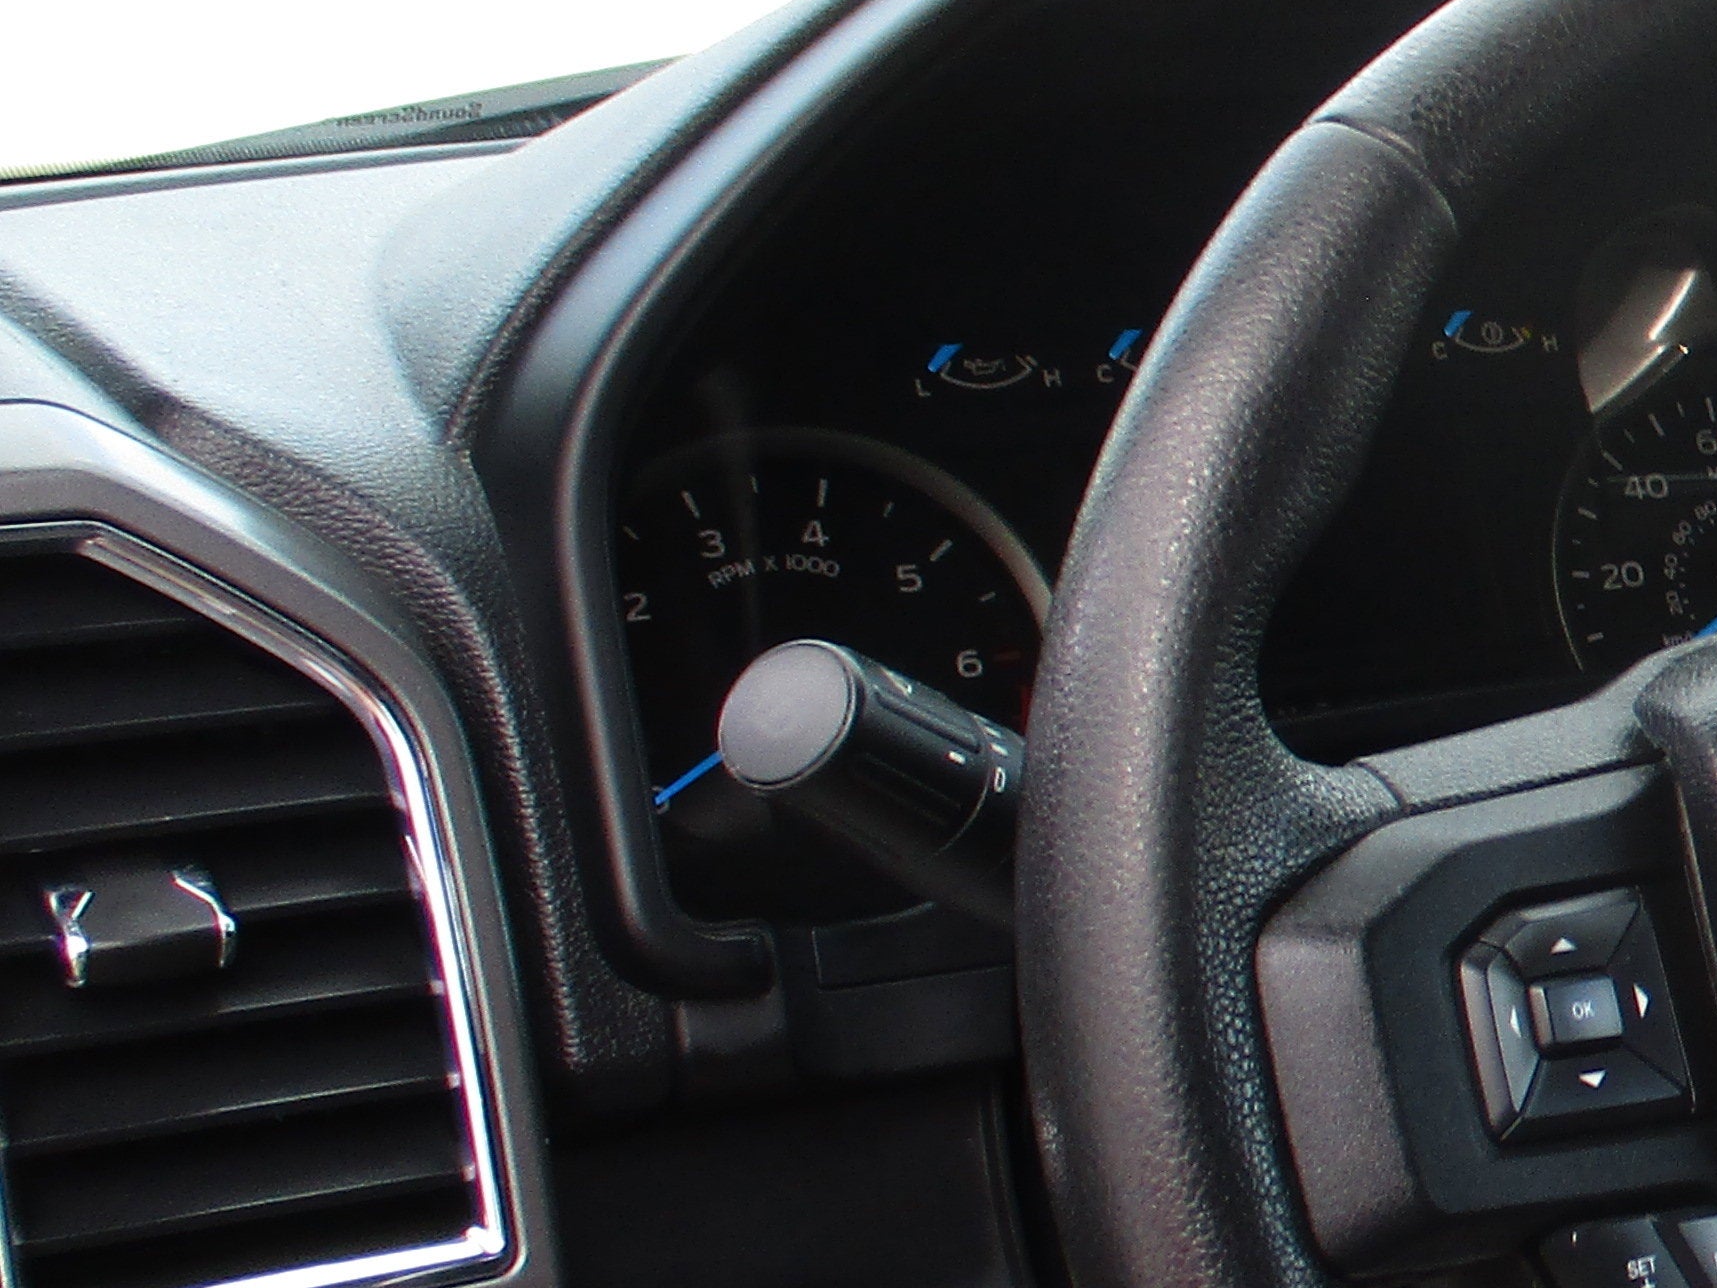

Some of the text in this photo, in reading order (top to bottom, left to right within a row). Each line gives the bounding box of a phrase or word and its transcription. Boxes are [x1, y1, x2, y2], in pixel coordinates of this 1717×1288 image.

[1043, 368, 1062, 387] H
[1096, 364, 1114, 383] C
[915, 379, 931, 397] L
[1625, 472, 1669, 500] 40
[698, 529, 725, 559] 3
[801, 520, 829, 547] 4
[707, 559, 756, 590] RPM
[785, 554, 841, 578] 1000
[895, 565, 923, 593] 5
[1601, 561, 1645, 590] 20
[623, 592, 651, 623] 2
[956, 650, 983, 679] 6
[1571, 1000, 1595, 1020] OK
[1626, 1254, 1657, 1281] SET
